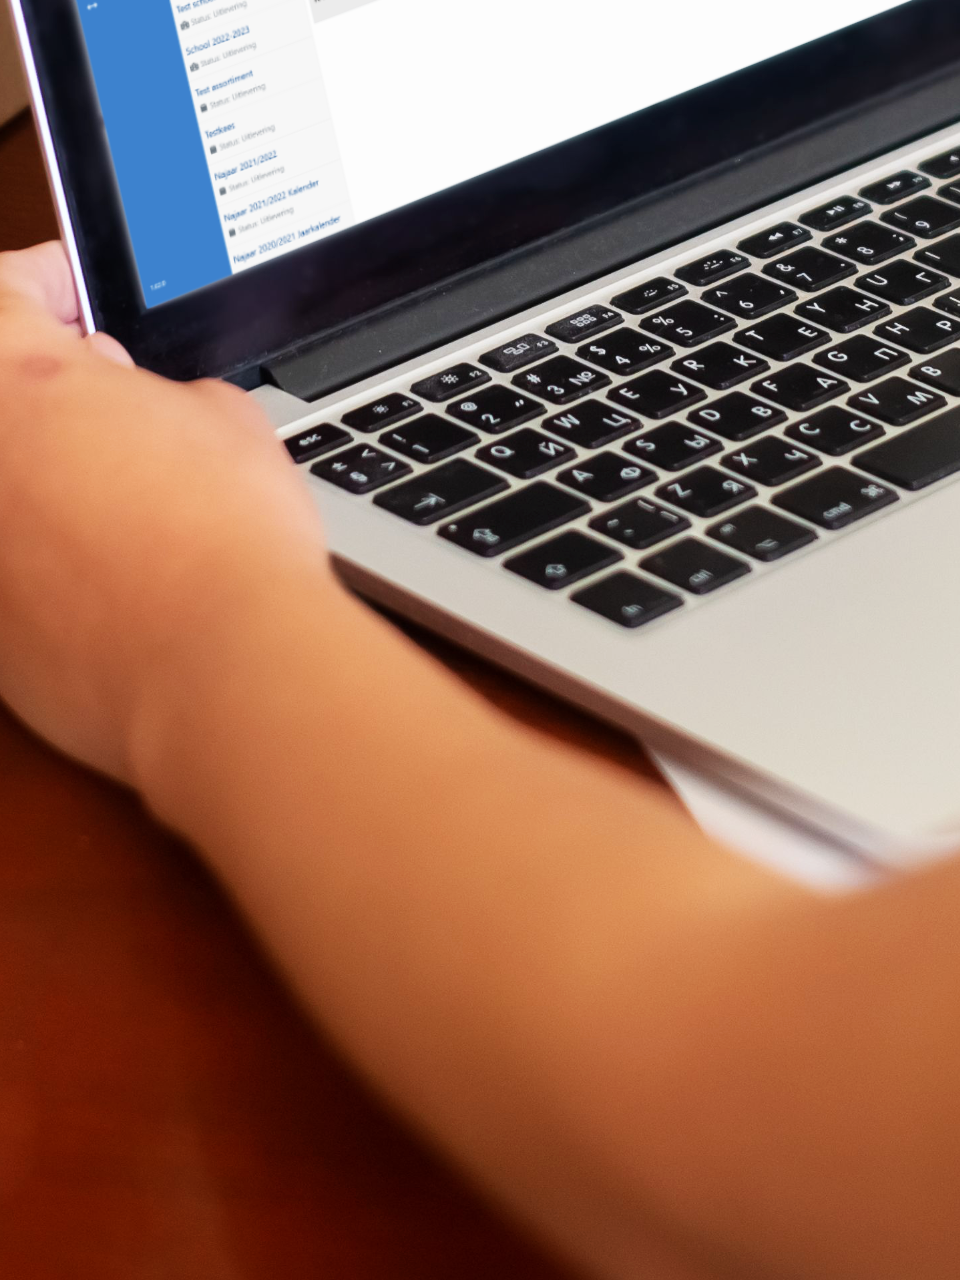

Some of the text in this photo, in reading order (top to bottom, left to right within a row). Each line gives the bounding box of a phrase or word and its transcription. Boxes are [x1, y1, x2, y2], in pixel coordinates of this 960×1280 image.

[175, 2, 192, 14] Test
[185, 25, 251, 57] School 2022-2023
[194, 69, 254, 97] Test assortiment
[213, 149, 278, 181] Najaar 2021/2022
[223, 179, 319, 223] Najaar 2021/2022 Kalender
[914, 220, 931, 229] 9
[232, 215, 341, 264] Najaar 2020/2021 Jaarkalender
[856, 246, 874, 255] 8
[796, 272, 813, 282] 7
[865, 274, 888, 286] U
[739, 300, 754, 309] 6
[805, 302, 826, 313] Y
[675, 326, 693, 337] 5
[744, 329, 764, 341] T
[885, 322, 910, 335] H
[615, 355, 631, 365] 4
[827, 350, 848, 362] G
[682, 359, 705, 371] R
[920, 365, 942, 377] B
[546, 384, 565, 395] 3
[761, 379, 778, 392] F
[618, 387, 640, 400] E
[858, 392, 880, 405] V
[481, 413, 501, 424] 2
[552, 412, 581, 429] W
[698, 409, 721, 422] D
[798, 422, 821, 435] C
[298, 432, 323, 447] esc
[635, 438, 656, 451] S
[490, 445, 515, 458] Q
[731, 451, 758, 468] X
[571, 469, 594, 483] A
[667, 482, 693, 498] Z
